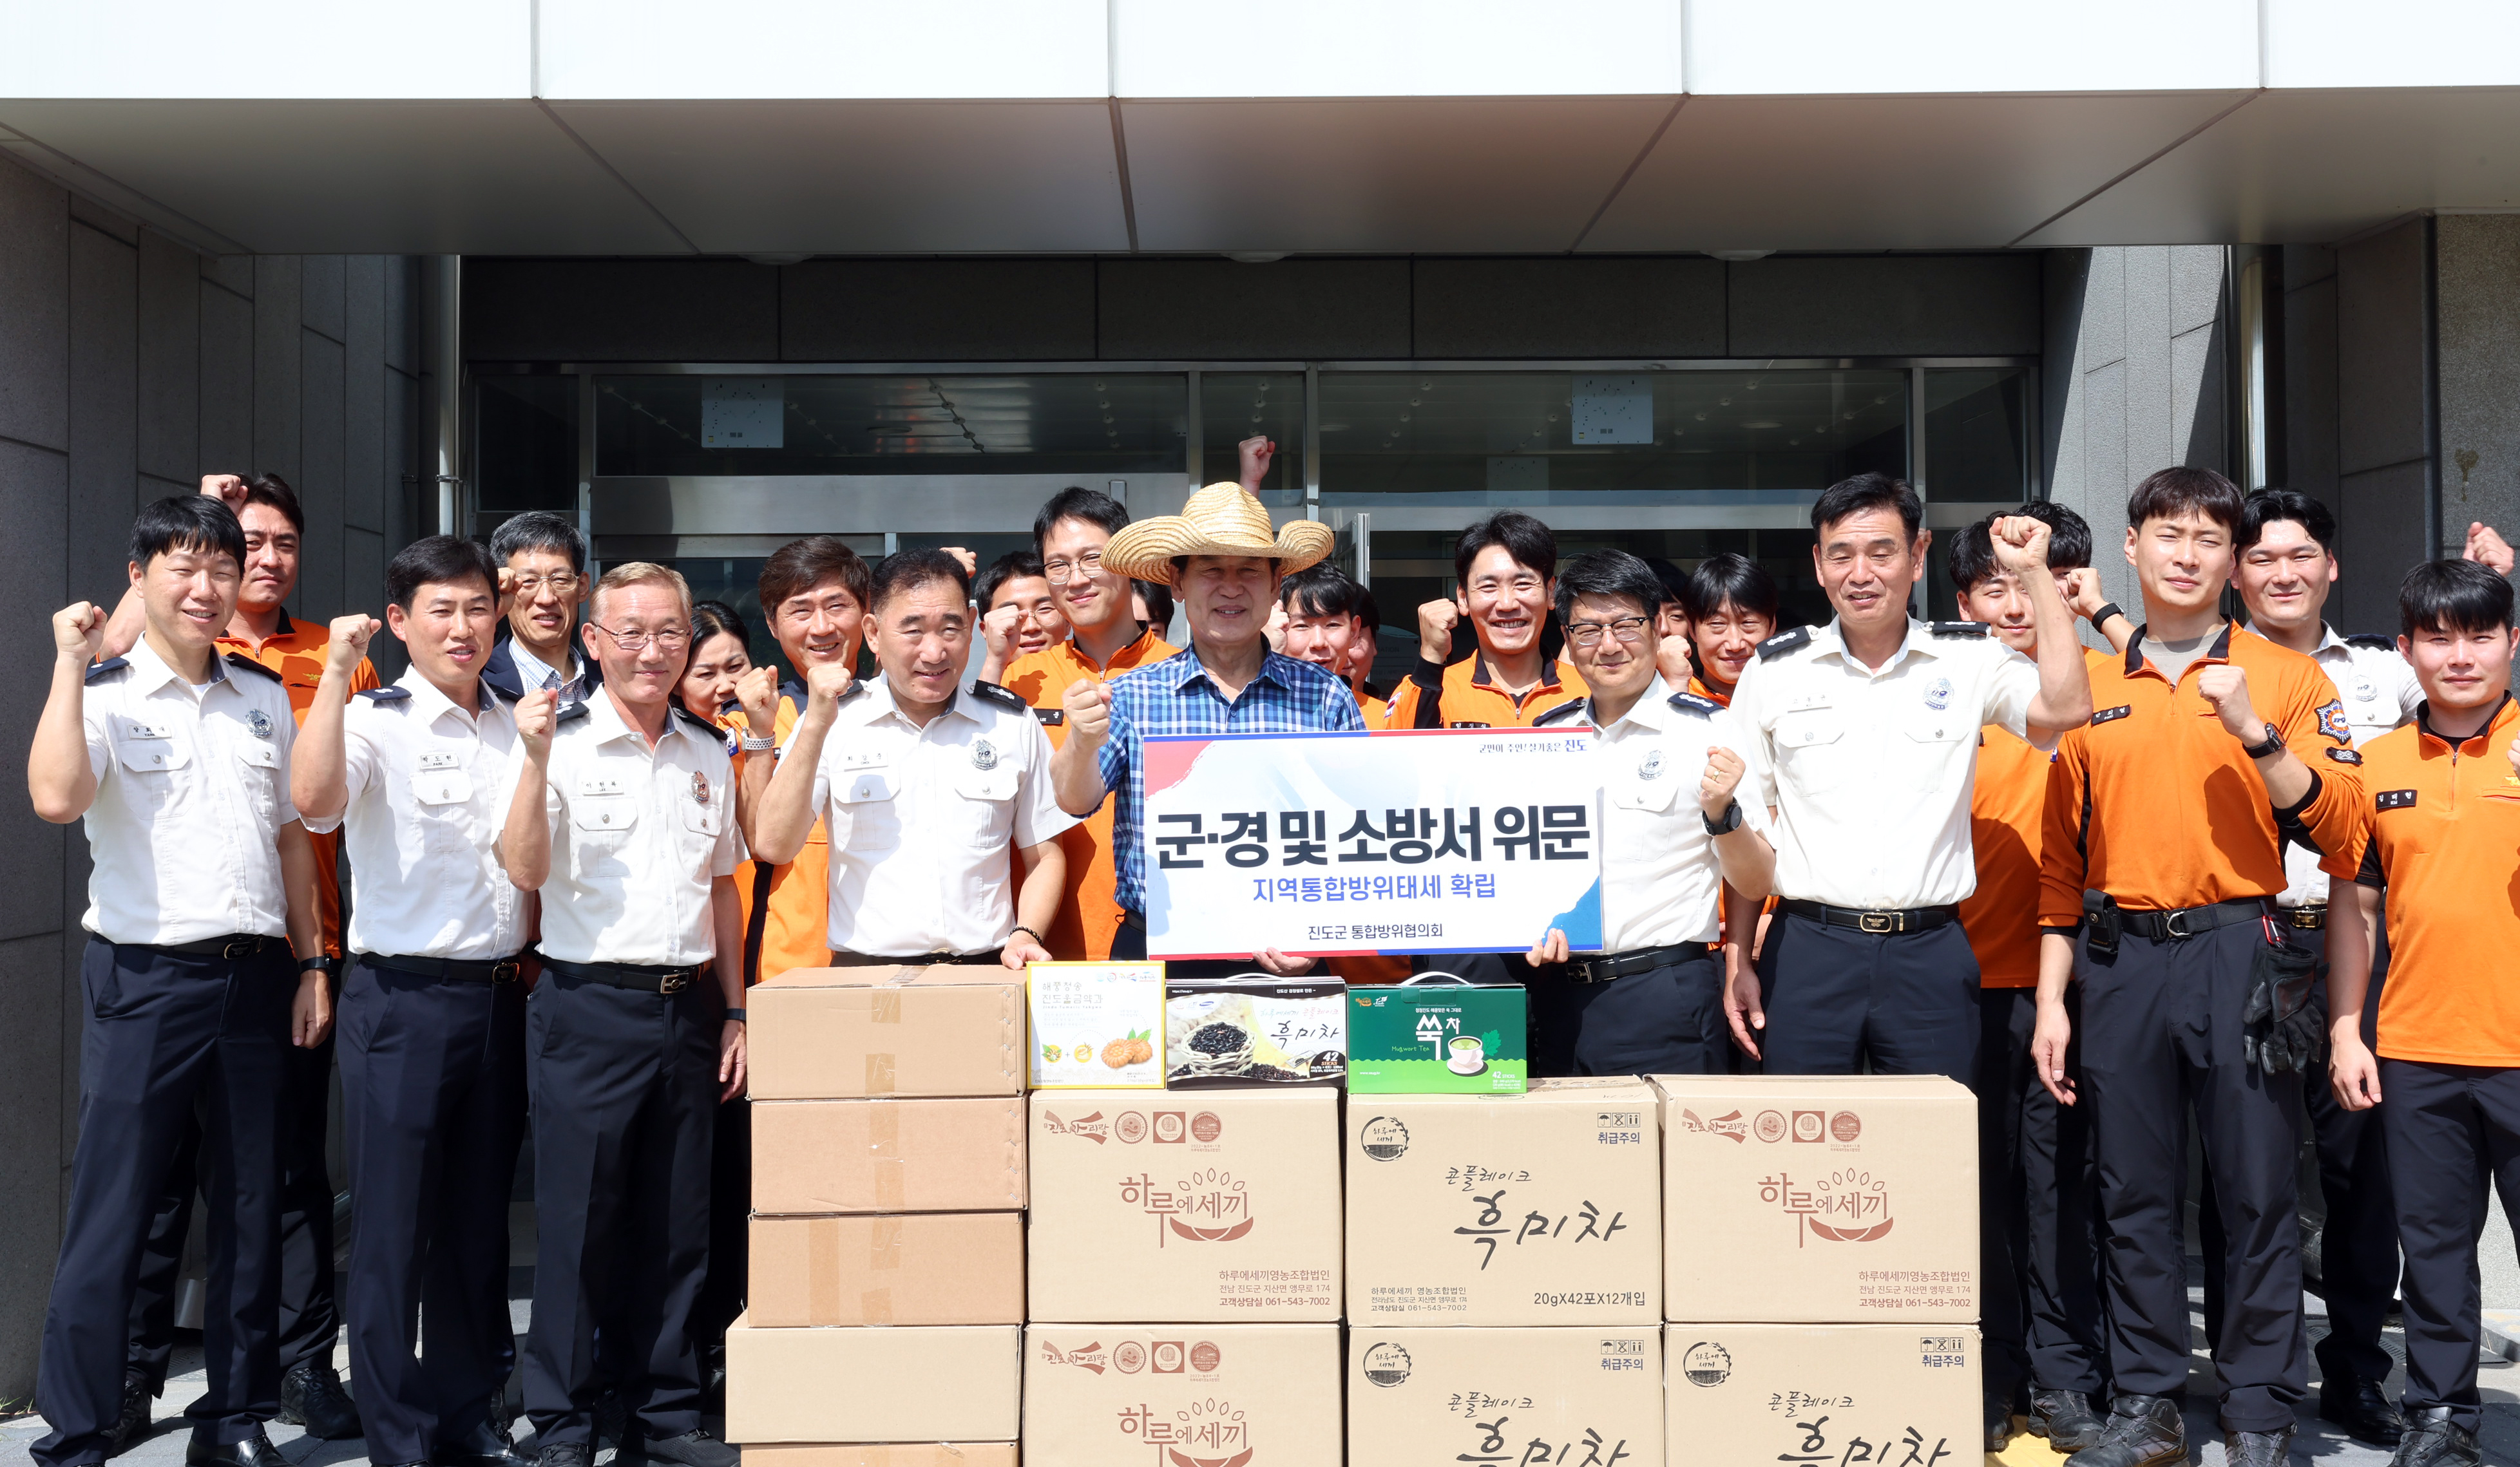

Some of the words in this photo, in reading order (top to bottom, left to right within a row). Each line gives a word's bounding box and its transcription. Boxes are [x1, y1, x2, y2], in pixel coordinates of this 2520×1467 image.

[1480, 744, 1503, 753] 군민이
[1507, 743, 1527, 753] 주인!
[1529, 743, 1561, 752] 살기좋은
[1565, 739, 1587, 752] 진도
[1155, 811, 1269, 870] 군·경
[1279, 809, 1328, 867] 및
[1338, 806, 1482, 864] 소방서
[1493, 805, 1590, 861] 위문
[1253, 875, 1441, 903] 지역통합방위태세
[1451, 873, 1495, 898] 확립
[1308, 925, 1348, 940] 진도군
[1351, 923, 1443, 940] 통합방위협의회
[1042, 981, 1082, 992] 해풍청송
[1042, 994, 1103, 1004] 진도울금약과
[1270, 1020, 1339, 1050] 흑미차
[1322, 1051, 1339, 1061] 42
[1373, 1127, 1397, 1135] 하루에
[1598, 1131, 1640, 1144] 취급주의
[1445, 1165, 1532, 1191] 콘플레이크
[1118, 1171, 1250, 1249] 하루에세끼
[1757, 1170, 1889, 1249] 하루에세끼
[1453, 1190, 1627, 1271] 흑미차
[1219, 1269, 1330, 1282] 하루에세끼영농조합법인
[1858, 1271, 1970, 1282] 하루에세끼영농조합법인
[1219, 1284, 1236, 1294] 전남
[1237, 1284, 1261, 1294] 진도군
[1263, 1284, 1287, 1294] 지산면
[1289, 1284, 1313, 1294] 앵무로
[1316, 1284, 1330, 1292] 174
[1371, 1287, 1412, 1296] 하루에세끼
[1417, 1287, 1466, 1296] 영농조합법인
[1859, 1285, 1875, 1294] 전남
[1877, 1285, 1902, 1294] 진도군
[1904, 1285, 1927, 1294] 지산면
[1929, 1285, 1954, 1295] 앵무로
[1956, 1285, 1971, 1294] 174
[1219, 1297, 1263, 1307] 고객상담실
[1265, 1297, 1330, 1306] 061-543-7002
[1534, 1291, 1645, 1307] 20gX42포X12개입
[1859, 1298, 1903, 1308] 고객상담실
[1905, 1298, 1971, 1307] 061-543-7002
[1375, 1352, 1399, 1361] 하루에
[1695, 1352, 1719, 1361] 하루에
[1922, 1354, 1964, 1368] 취급주의
[1601, 1358, 1643, 1371] 취급주의
[1447, 1391, 1534, 1418] 콘플레이크
[1768, 1390, 1855, 1417] 콘플레이크
[1117, 1401, 1249, 1467] 하루에세끼
